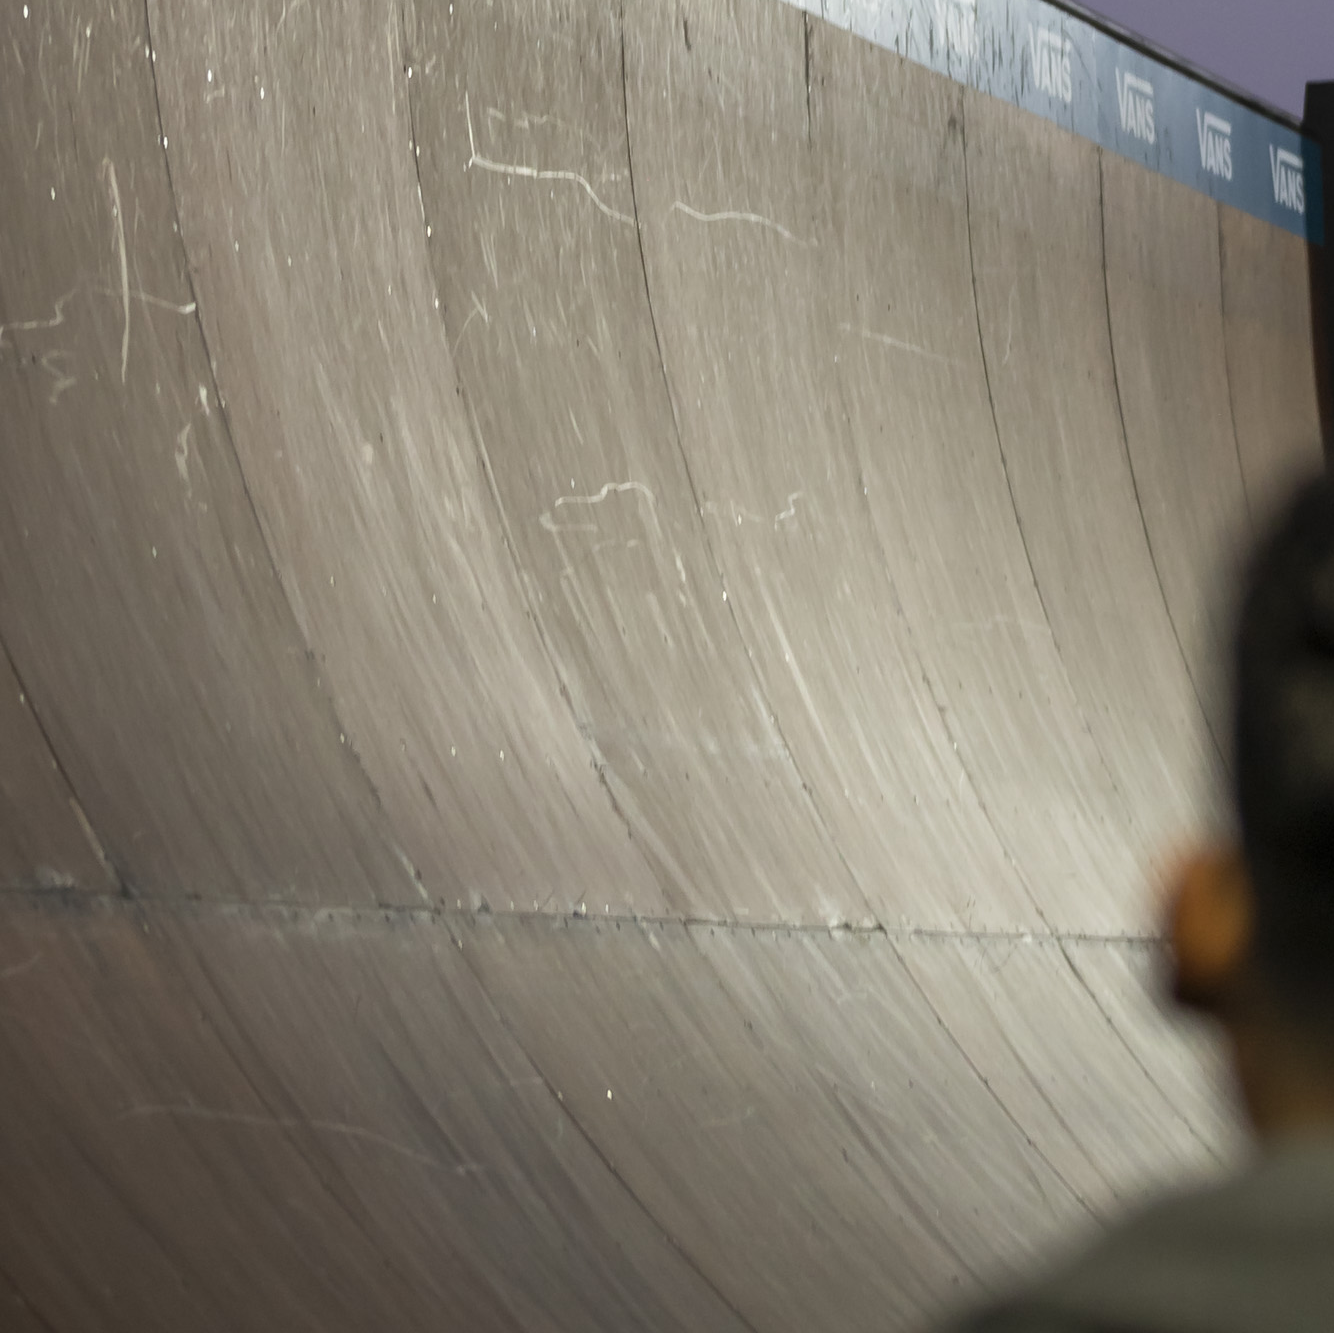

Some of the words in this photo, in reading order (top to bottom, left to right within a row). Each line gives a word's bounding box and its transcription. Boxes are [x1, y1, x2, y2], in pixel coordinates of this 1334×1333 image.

[1114, 65, 1157, 146] VANS
[1195, 106, 1233, 182] VANS
[1268, 142, 1306, 215] VANS
